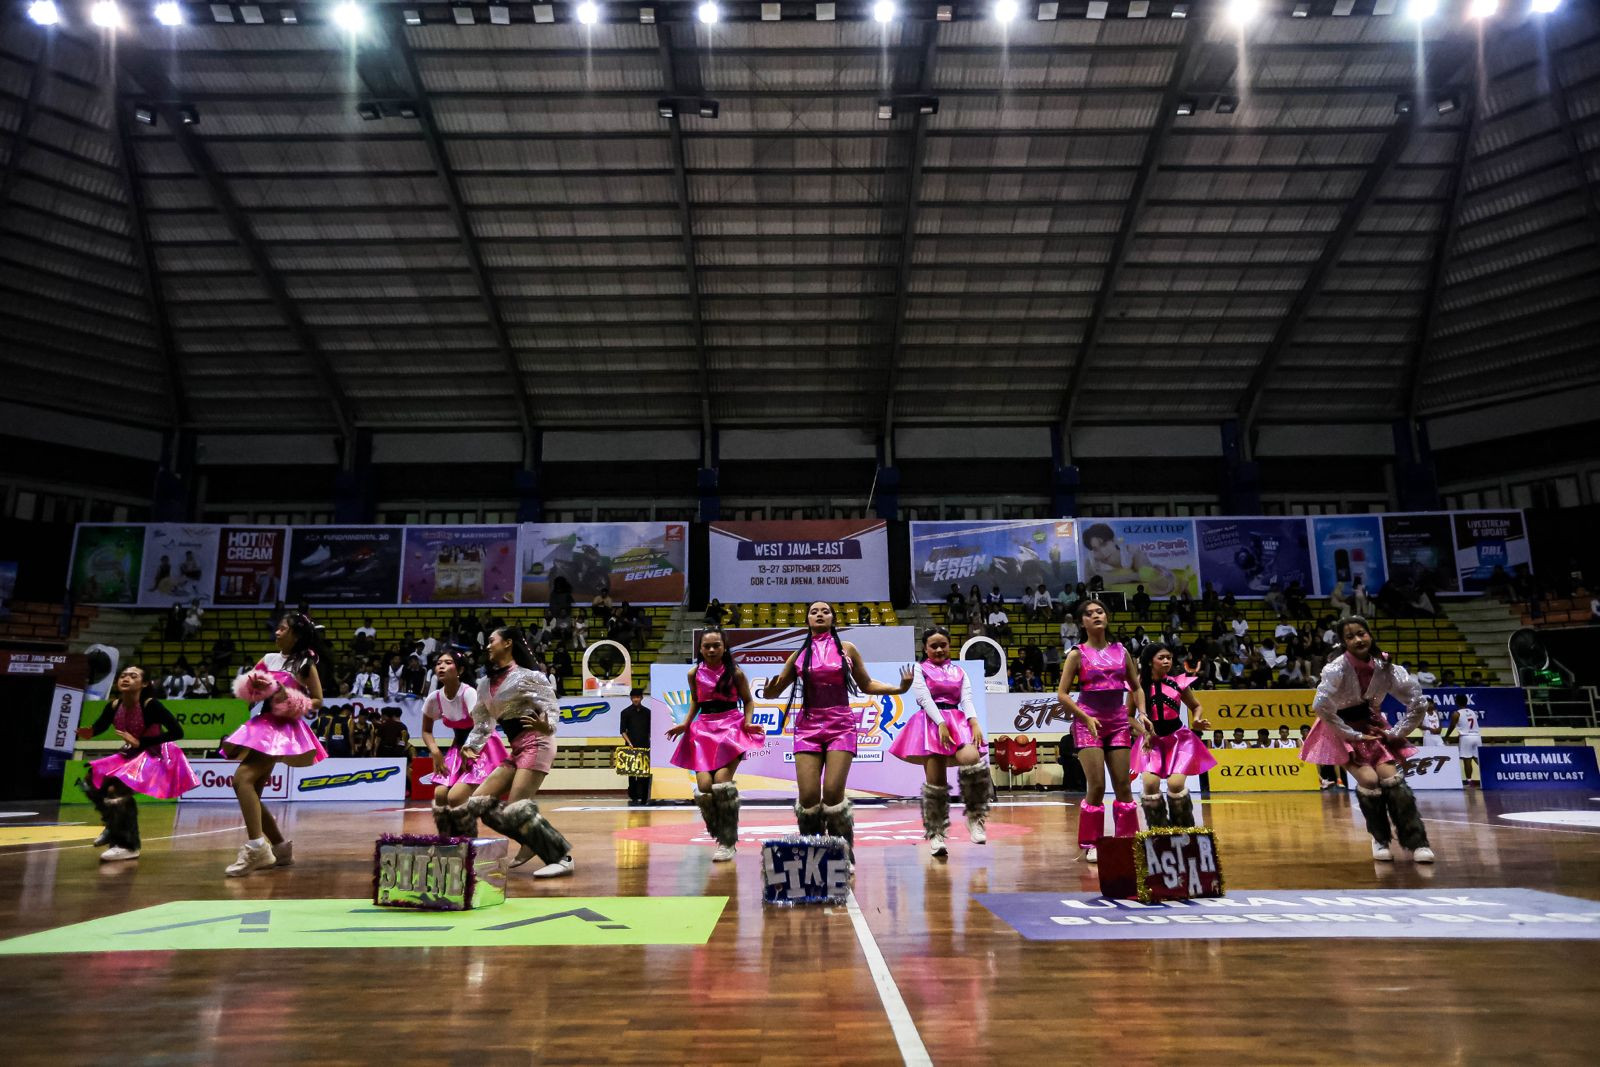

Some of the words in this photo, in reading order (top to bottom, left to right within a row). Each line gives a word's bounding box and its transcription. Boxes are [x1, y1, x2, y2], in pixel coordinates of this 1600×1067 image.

[1467, 519, 1511, 529] LIVESTREAM
[1481, 528, 1509, 537] UPDATE
[228, 532, 257, 547] HOT
[227, 547, 273, 560] CREAM
[754, 543, 783, 557] WEST
[787, 541, 845, 556] JAVA-EAST
[758, 565, 780, 573] 13-27
[782, 564, 820, 573] SEPTEMBER
[822, 564, 842, 573] 2025
[924, 554, 987, 573] KEREN
[624, 568, 673, 582] BENER
[751, 577, 764, 585] GOR
[767, 577, 788, 585] C-TRA
[817, 576, 849, 585] BANDUNG
[934, 566, 978, 582] KAN!
[10, 654, 30, 663] WEST
[745, 655, 785, 663] HONDA
[62, 693, 72, 713] LOUD
[58, 713, 69, 729] GET
[751, 713, 776, 725] DBL
[1467, 718, 1475, 730] 7
[1500, 753, 1538, 765] ULTRA
[1540, 753, 1572, 765] MILK
[1220, 763, 1300, 777] azarine
[1496, 771, 1550, 781] BLUEBERRY
[1553, 771, 1585, 781] BLAST
[202, 770, 234, 788] Goo
[763, 846, 848, 898] LIKE
[1060, 897, 1301, 910] ULTRA
[1300, 896, 1507, 906] MILK
[1050, 914, 1398, 925] BLUEBERRY
